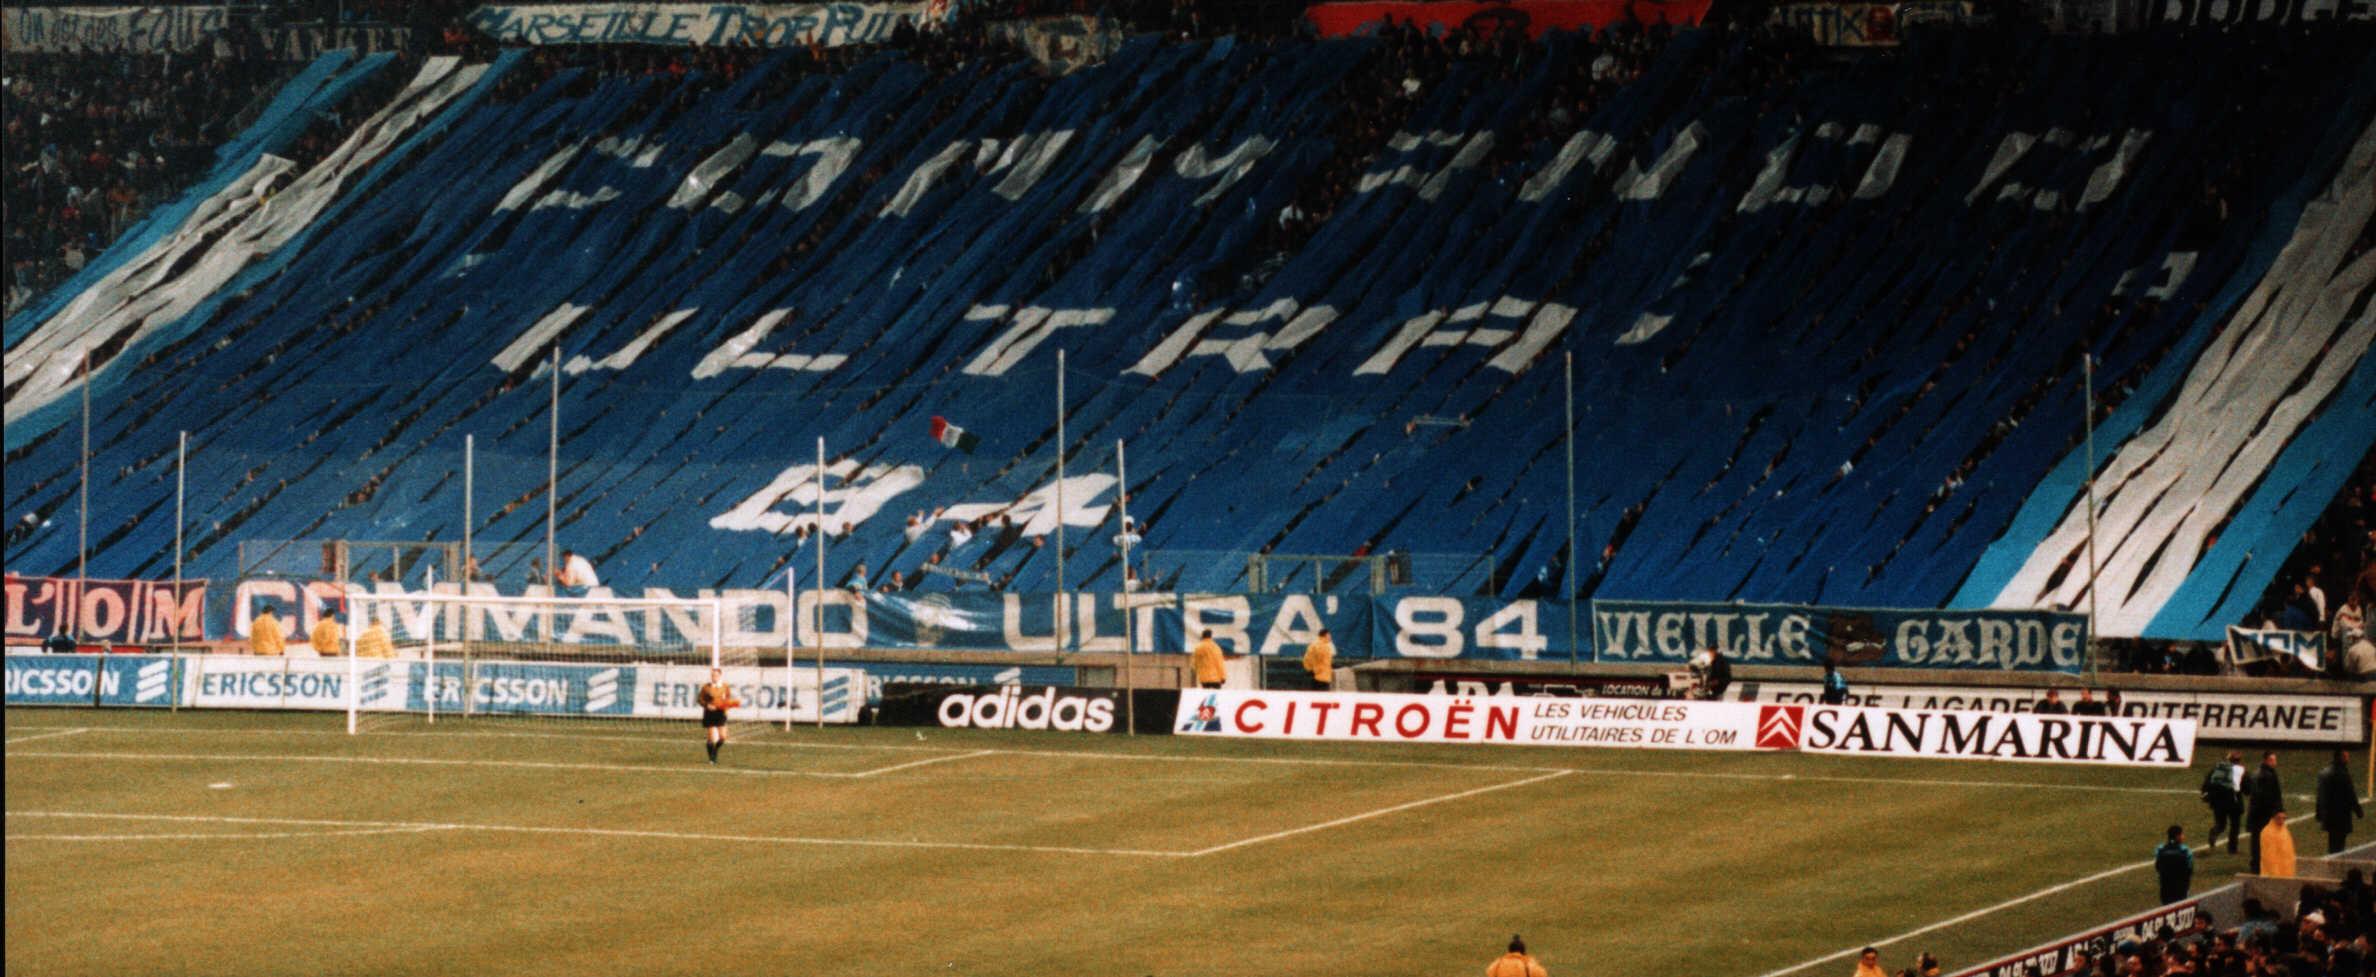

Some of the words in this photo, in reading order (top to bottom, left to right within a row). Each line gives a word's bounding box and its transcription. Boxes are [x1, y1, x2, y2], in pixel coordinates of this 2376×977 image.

[1395, 596, 1548, 661] 84
[1600, 610, 1812, 663] VIEILLE
[1895, 616, 2083, 670] GARDE
[203, 671, 341, 699] ERICSSON
[938, 686, 1114, 732] adidas
[1235, 698, 1520, 740] CITROËN
[1534, 703, 1570, 718] LES
[1580, 704, 1687, 721] VEHICULES
[1531, 725, 1642, 743] UTILITAIRES
[1650, 728, 1675, 744] DE
[1808, 709, 1932, 753] SAN
[1939, 712, 2185, 763] MARINA
